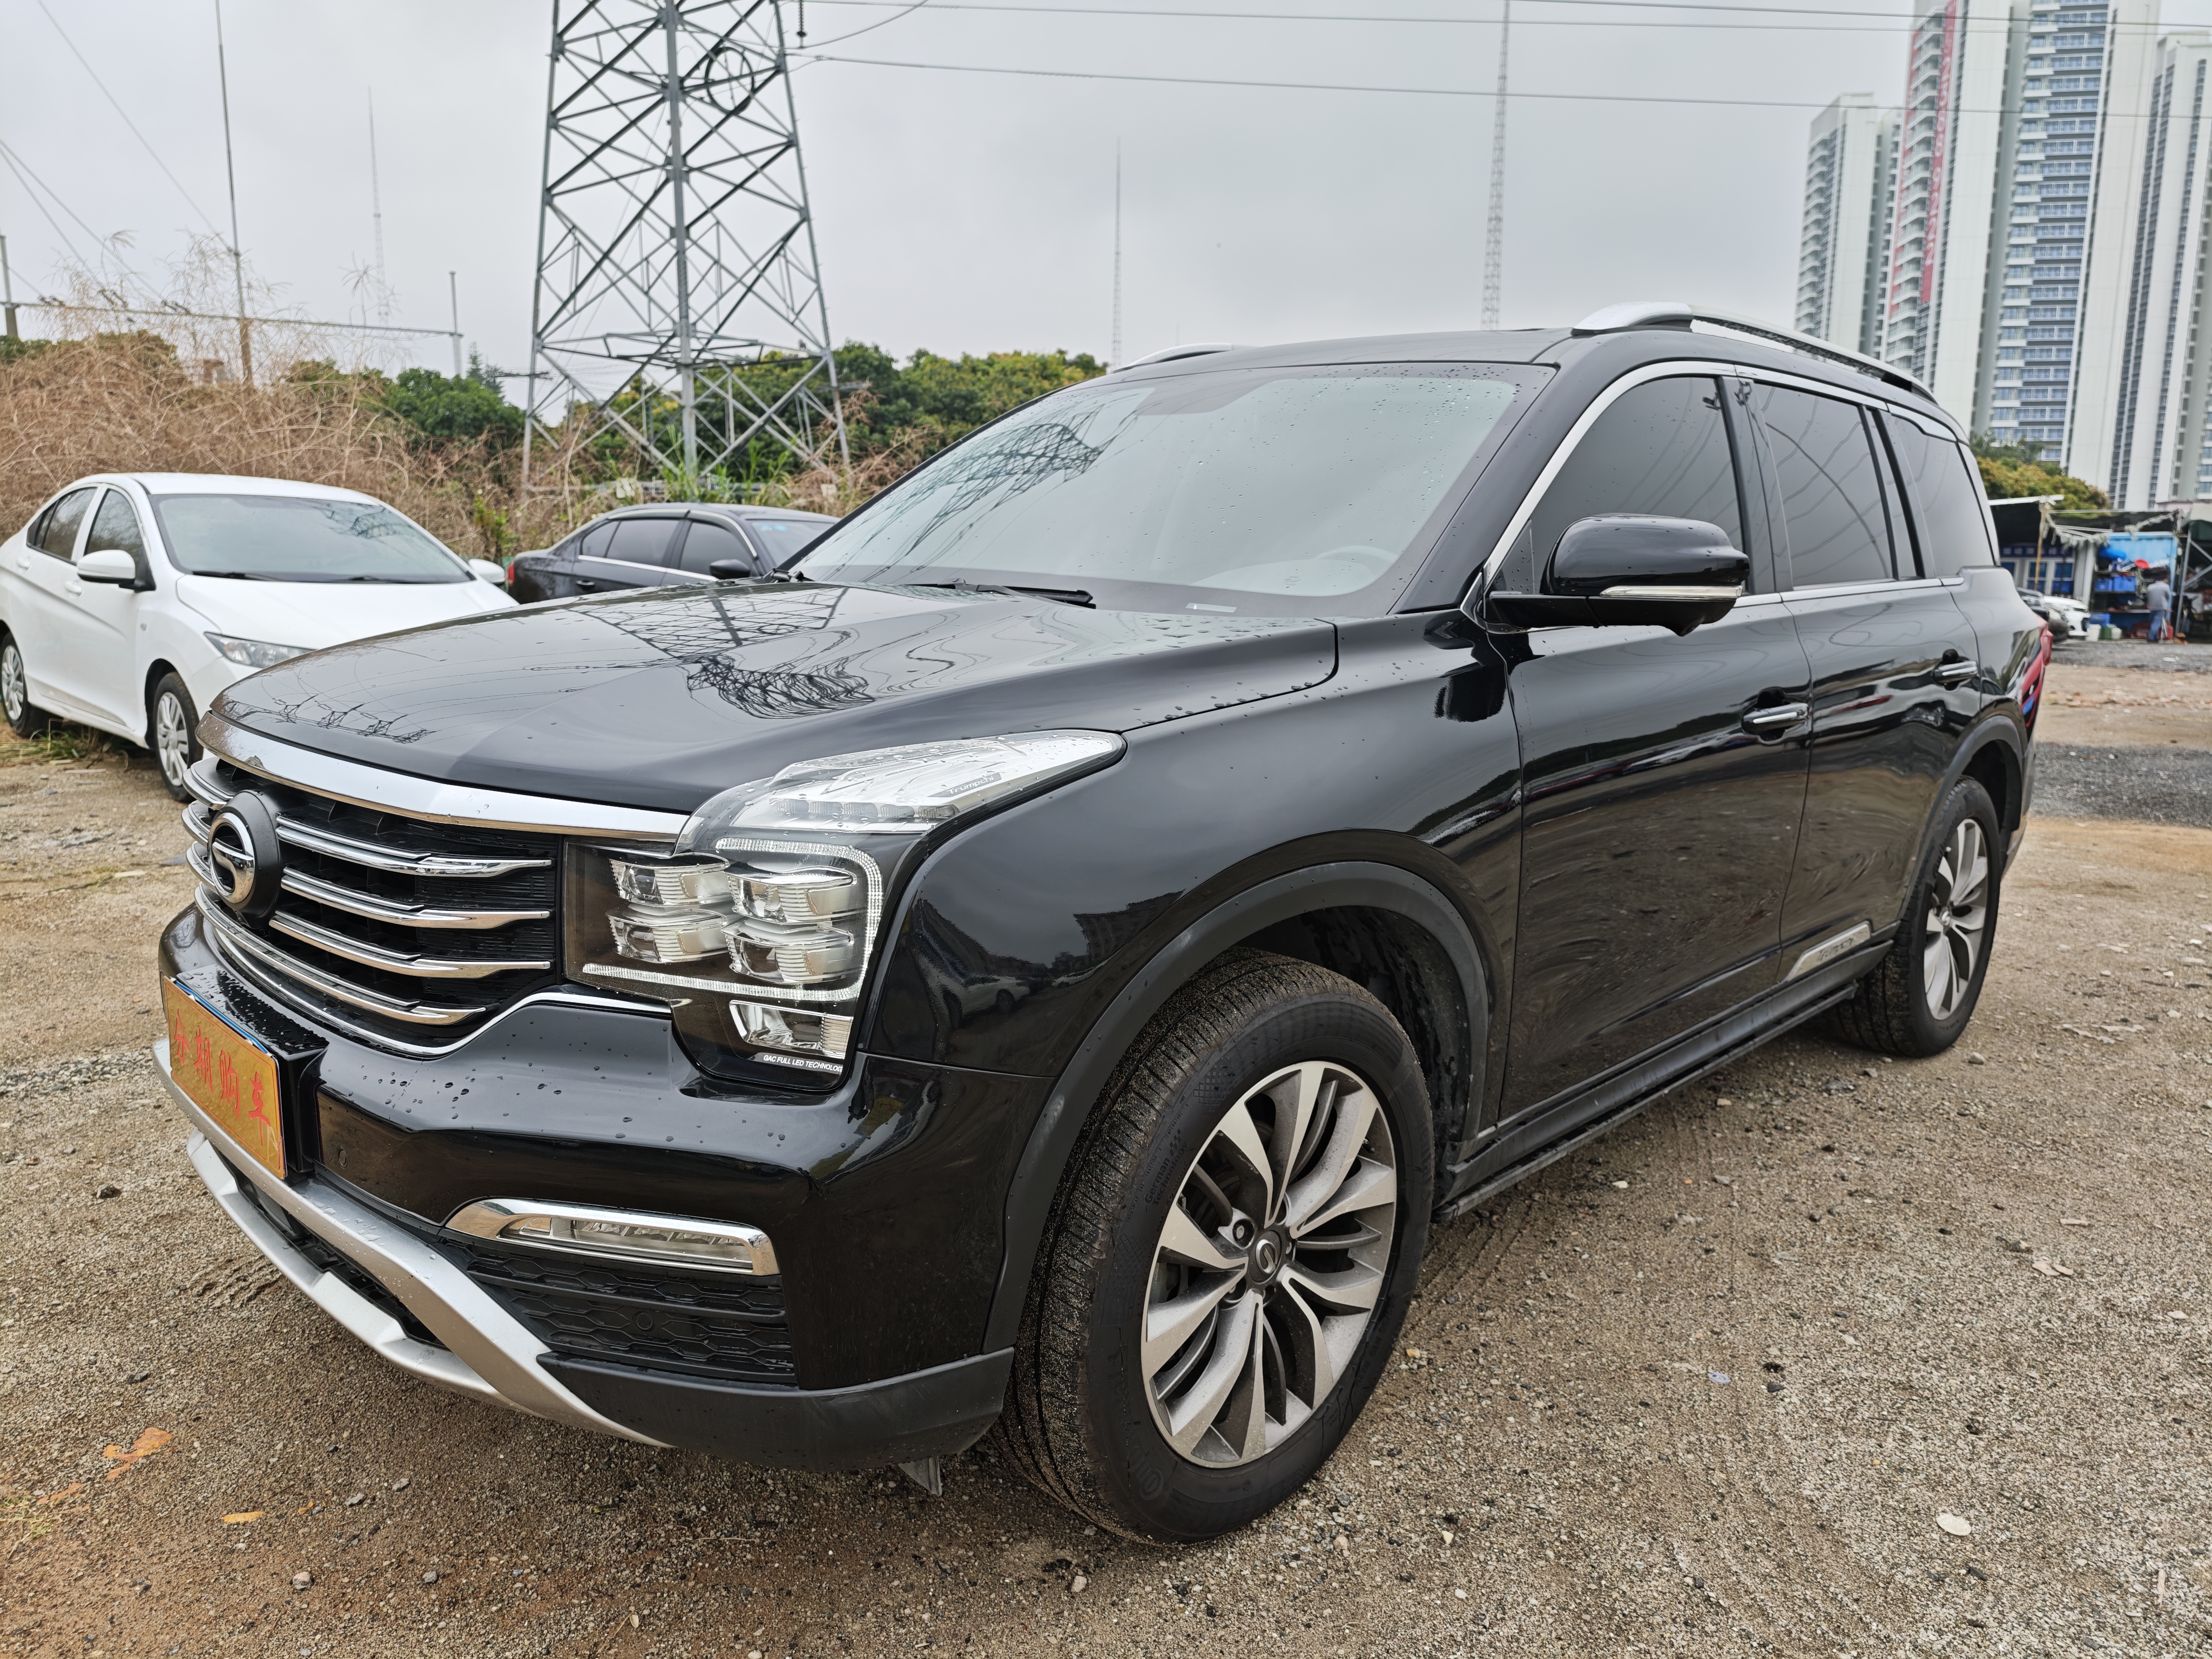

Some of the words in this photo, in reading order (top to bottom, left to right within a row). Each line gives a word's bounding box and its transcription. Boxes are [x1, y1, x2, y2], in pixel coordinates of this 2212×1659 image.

[946, 775, 995, 794] Trumpchi
[173, 1008, 271, 1146] 分期购车
[1145, 1155, 1157, 1177] TRACTION
[1164, 1111, 1183, 1140] TEMPERATURE
[1152, 1141, 1188, 1206] Technology
[1144, 1156, 1171, 1204] German
